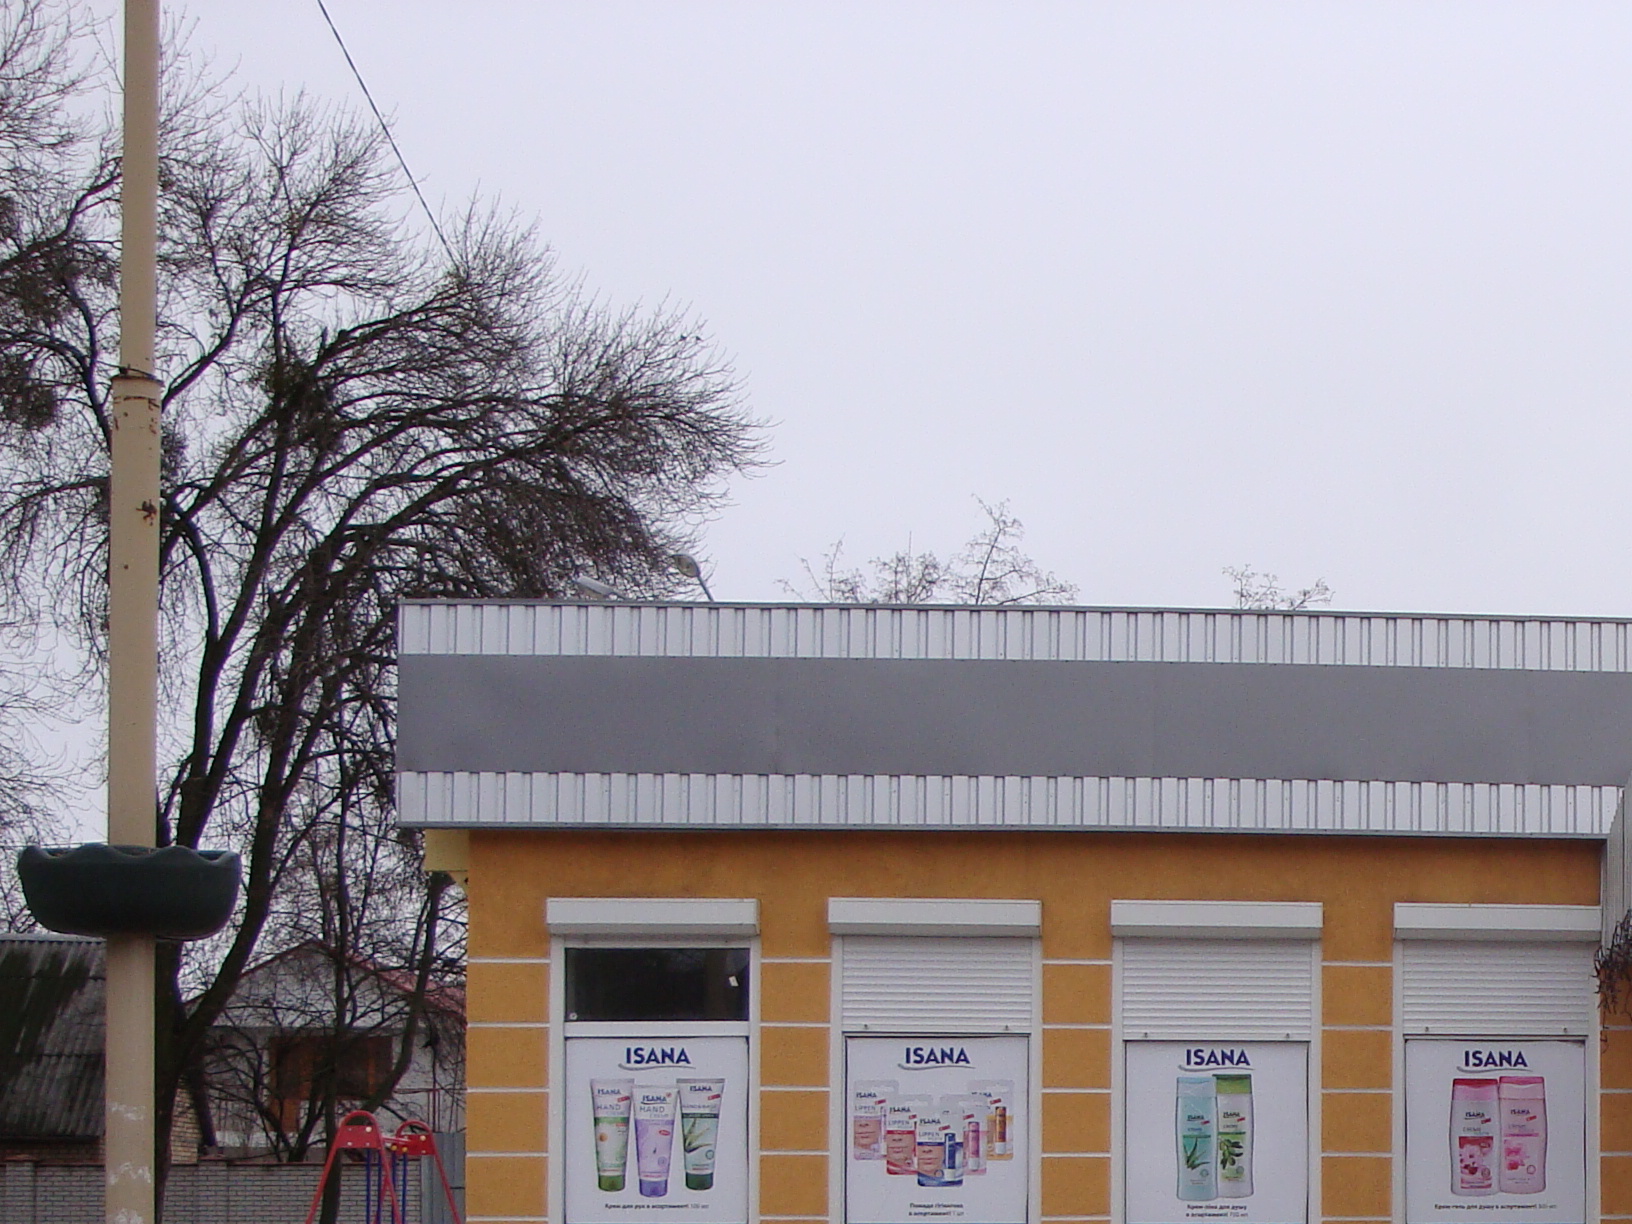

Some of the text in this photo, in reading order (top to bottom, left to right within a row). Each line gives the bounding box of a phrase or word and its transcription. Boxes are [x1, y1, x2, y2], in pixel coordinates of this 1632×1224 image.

[626, 1047, 691, 1064] ISANA
[905, 1047, 970, 1064] ISANA
[1186, 1049, 1251, 1066] ISANA
[1464, 1050, 1528, 1067] ISANA
